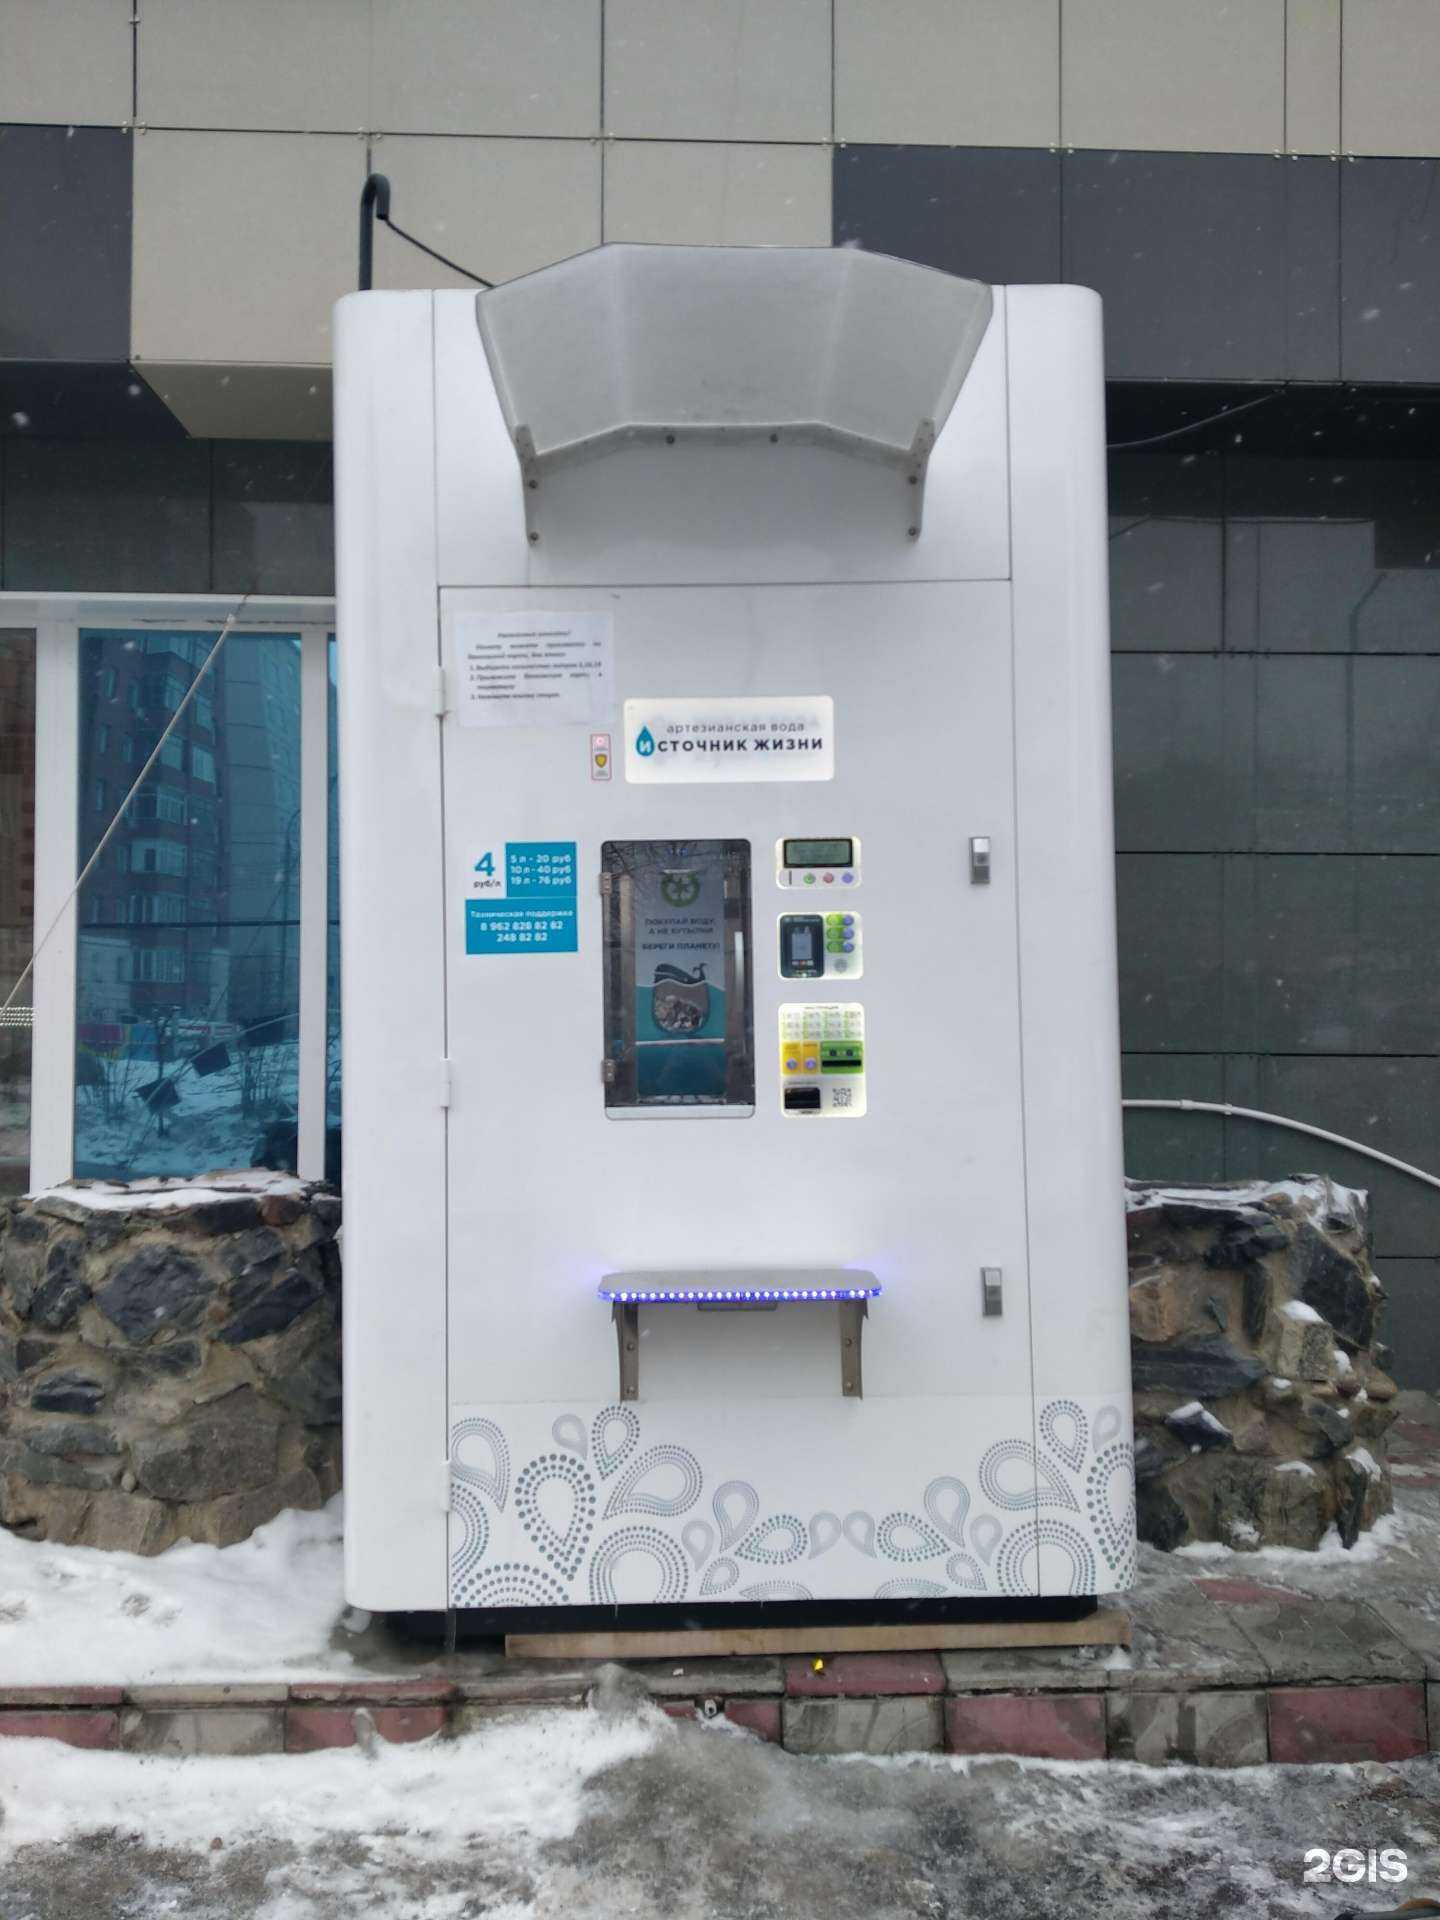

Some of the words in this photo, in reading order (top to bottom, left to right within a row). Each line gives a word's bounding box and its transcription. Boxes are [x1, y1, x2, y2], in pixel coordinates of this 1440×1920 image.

[666, 723, 767, 734] артезианская
[770, 721, 805, 733] вода
[753, 737, 824, 751] ЖИЗНИ
[475, 852, 495, 876] 4
